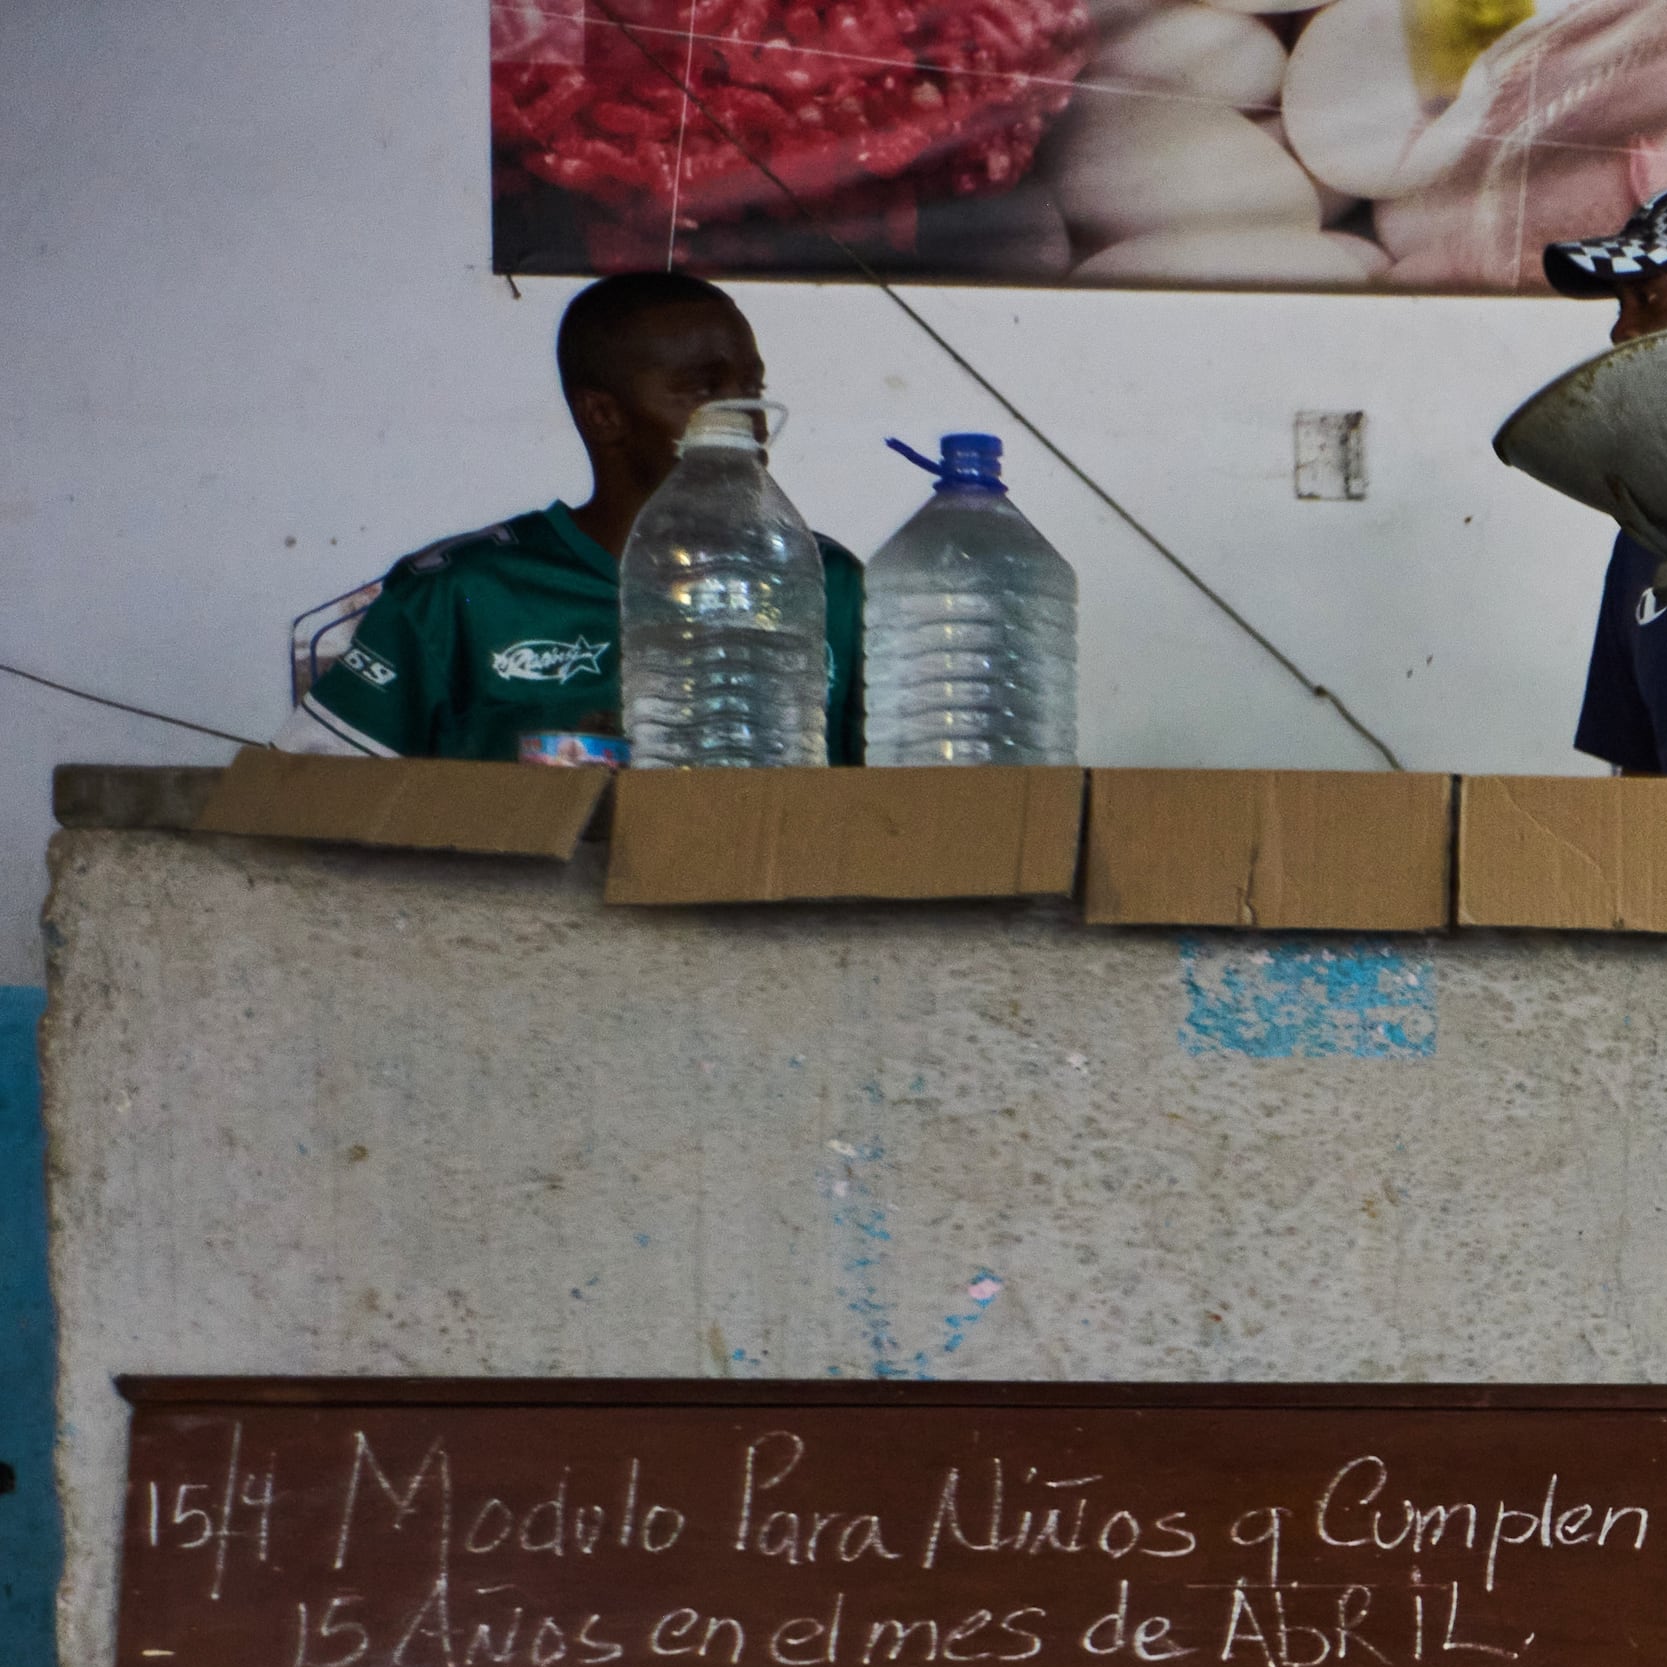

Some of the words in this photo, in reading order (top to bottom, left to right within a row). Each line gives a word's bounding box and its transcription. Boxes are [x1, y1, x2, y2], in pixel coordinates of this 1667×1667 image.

[344, 648, 398, 686] 69
[147, 1422, 274, 1599] 15/4
[734, 1430, 902, 1566] Para
[1317, 1455, 1649, 1592] Cumplen
[650, 1607, 746, 1665] en
[769, 1592, 846, 1667] el
[862, 1606, 1047, 1664] mes
[1081, 1578, 1200, 1662] de
